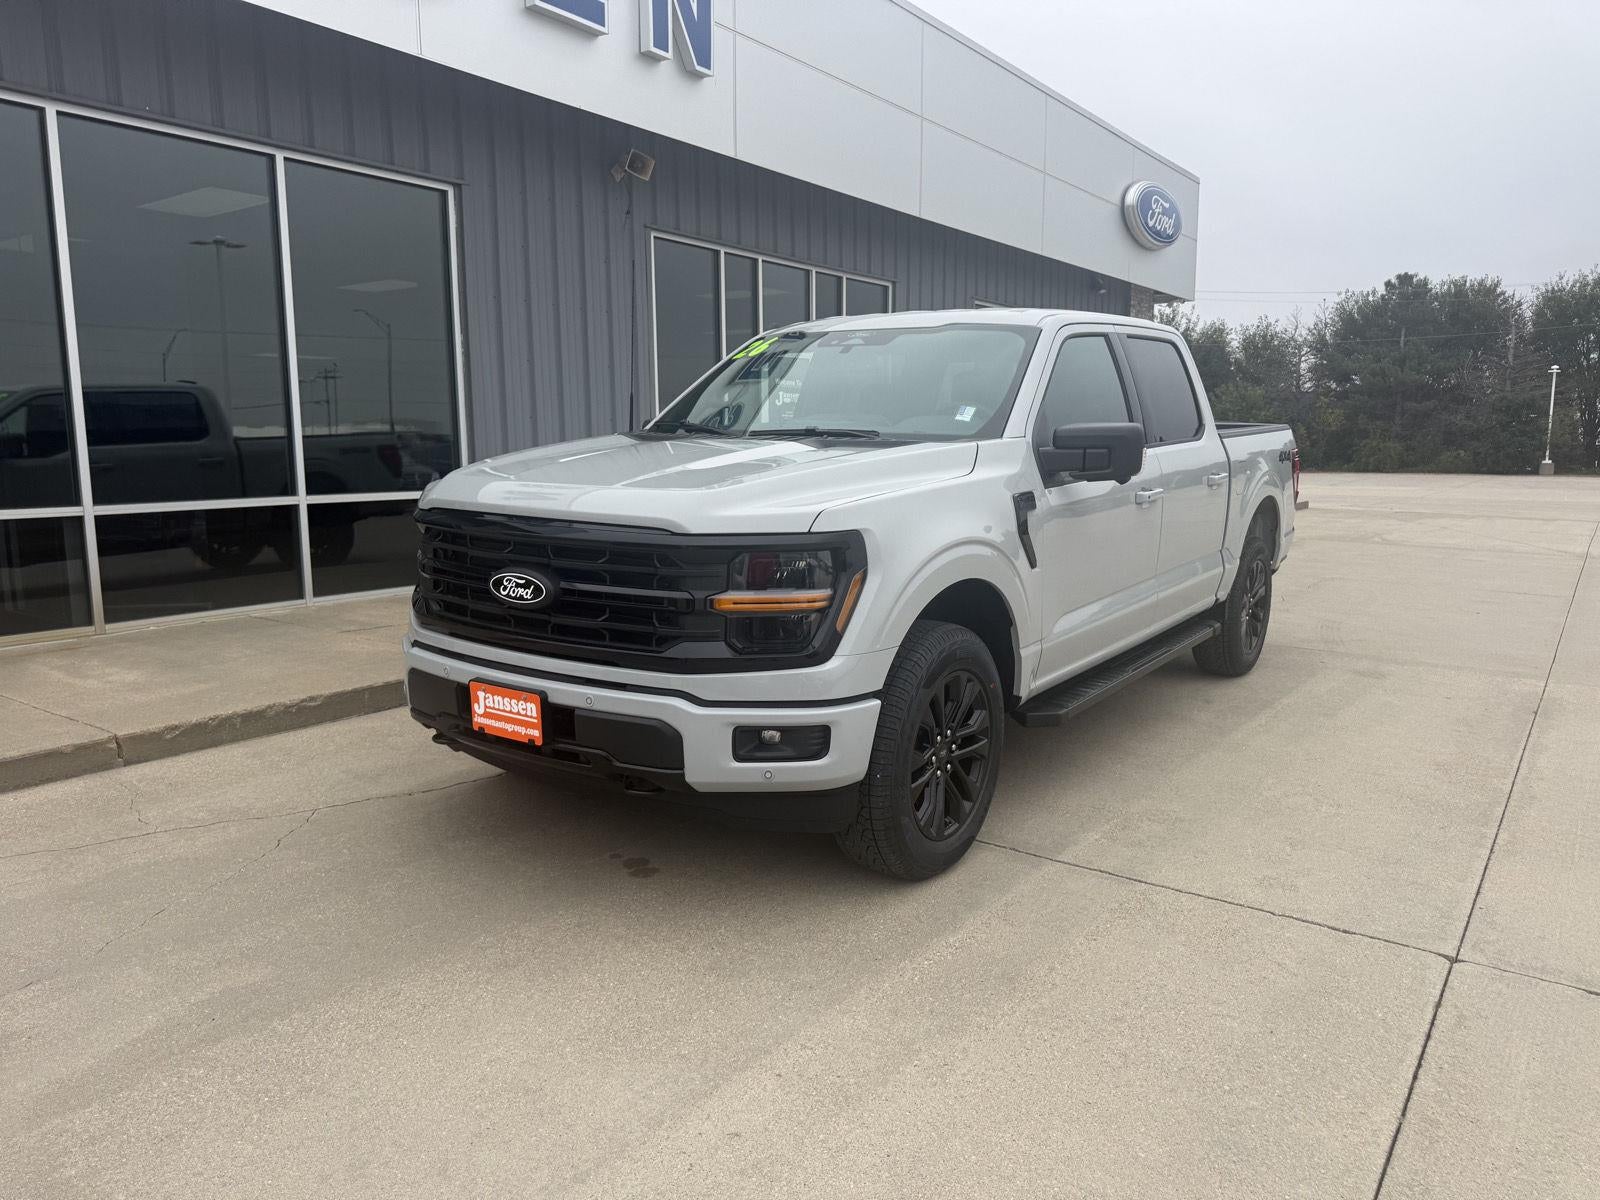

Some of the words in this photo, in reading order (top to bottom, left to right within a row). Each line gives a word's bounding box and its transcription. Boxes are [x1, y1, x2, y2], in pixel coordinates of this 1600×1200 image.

[1147, 195, 1176, 236] Ford
[732, 336, 779, 360] 26
[499, 576, 535, 600] Ford
[474, 691, 538, 718] Janssen
